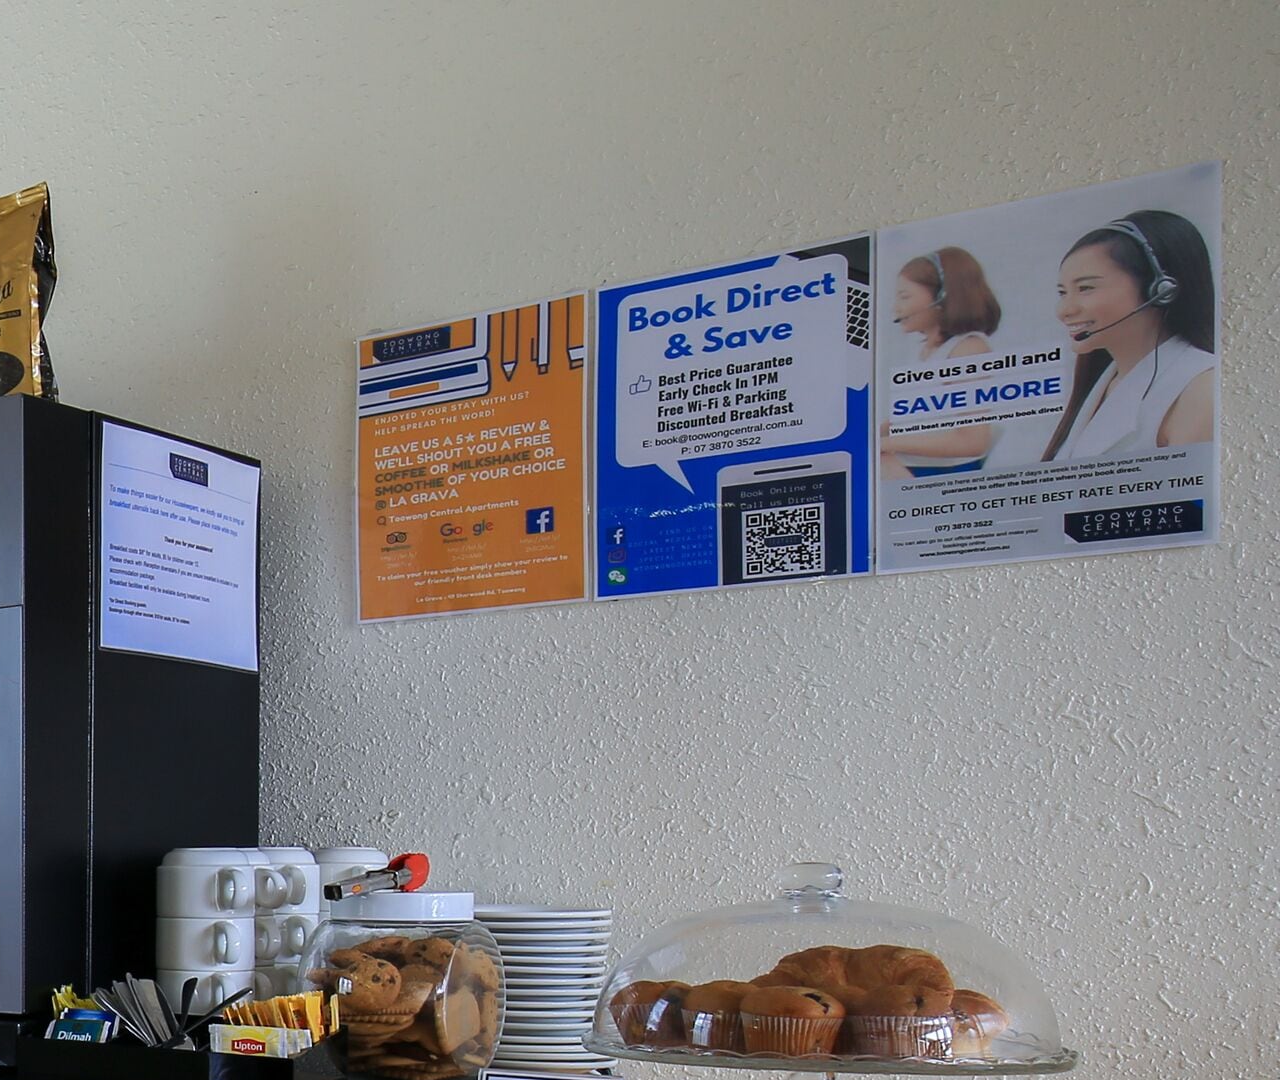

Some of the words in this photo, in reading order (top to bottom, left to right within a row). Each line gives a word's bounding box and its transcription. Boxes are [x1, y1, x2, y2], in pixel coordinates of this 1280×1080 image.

[629, 294, 716, 331] Book
[727, 273, 836, 313] Direct
[664, 334, 693, 359] &
[701, 323, 793, 352] Save
[659, 372, 685, 387] Best
[690, 367, 722, 382] Price
[727, 356, 793, 376] Guarantee
[892, 368, 935, 385] Give
[939, 365, 961, 378] us
[966, 364, 977, 375] a
[981, 356, 1016, 371] call
[1022, 349, 1061, 367] and
[375, 412, 417, 425] ENJOYED
[421, 407, 447, 417] YOUR
[451, 401, 477, 412] STAY
[481, 396, 506, 406] WITH
[510, 391, 529, 401] US?
[658, 406, 683, 417] Free
[688, 400, 719, 412] Wi-Fi
[722, 396, 731, 407] &
[736, 389, 787, 405] Parking
[892, 391, 967, 416] SAVE
[975, 377, 1061, 404] MORE
[375, 427, 396, 436] HELP
[401, 419, 436, 432] SPREAD
[441, 415, 457, 423] THE
[461, 410, 495, 420] WORD!
[657, 413, 726, 433] Discounted
[730, 402, 794, 421] Breakfast
[906, 424, 920, 432] will
[921, 423, 938, 431] beat
[940, 420, 955, 429] any
[957, 417, 972, 426] rate
[974, 415, 997, 423] when
[999, 413, 1014, 422] you
[1016, 409, 1038, 418] book
[1039, 406, 1064, 415] direct
[694, 444, 707, 452] 07
[709, 441, 733, 451] 3870
[737, 437, 761, 448] 3522
[1083, 516, 1181, 532] CENTRAL
[1084, 507, 1184, 523] TOOWONG
[58, 1031, 92, 1042] Dilmah
[234, 1041, 262, 1052] Lipton
